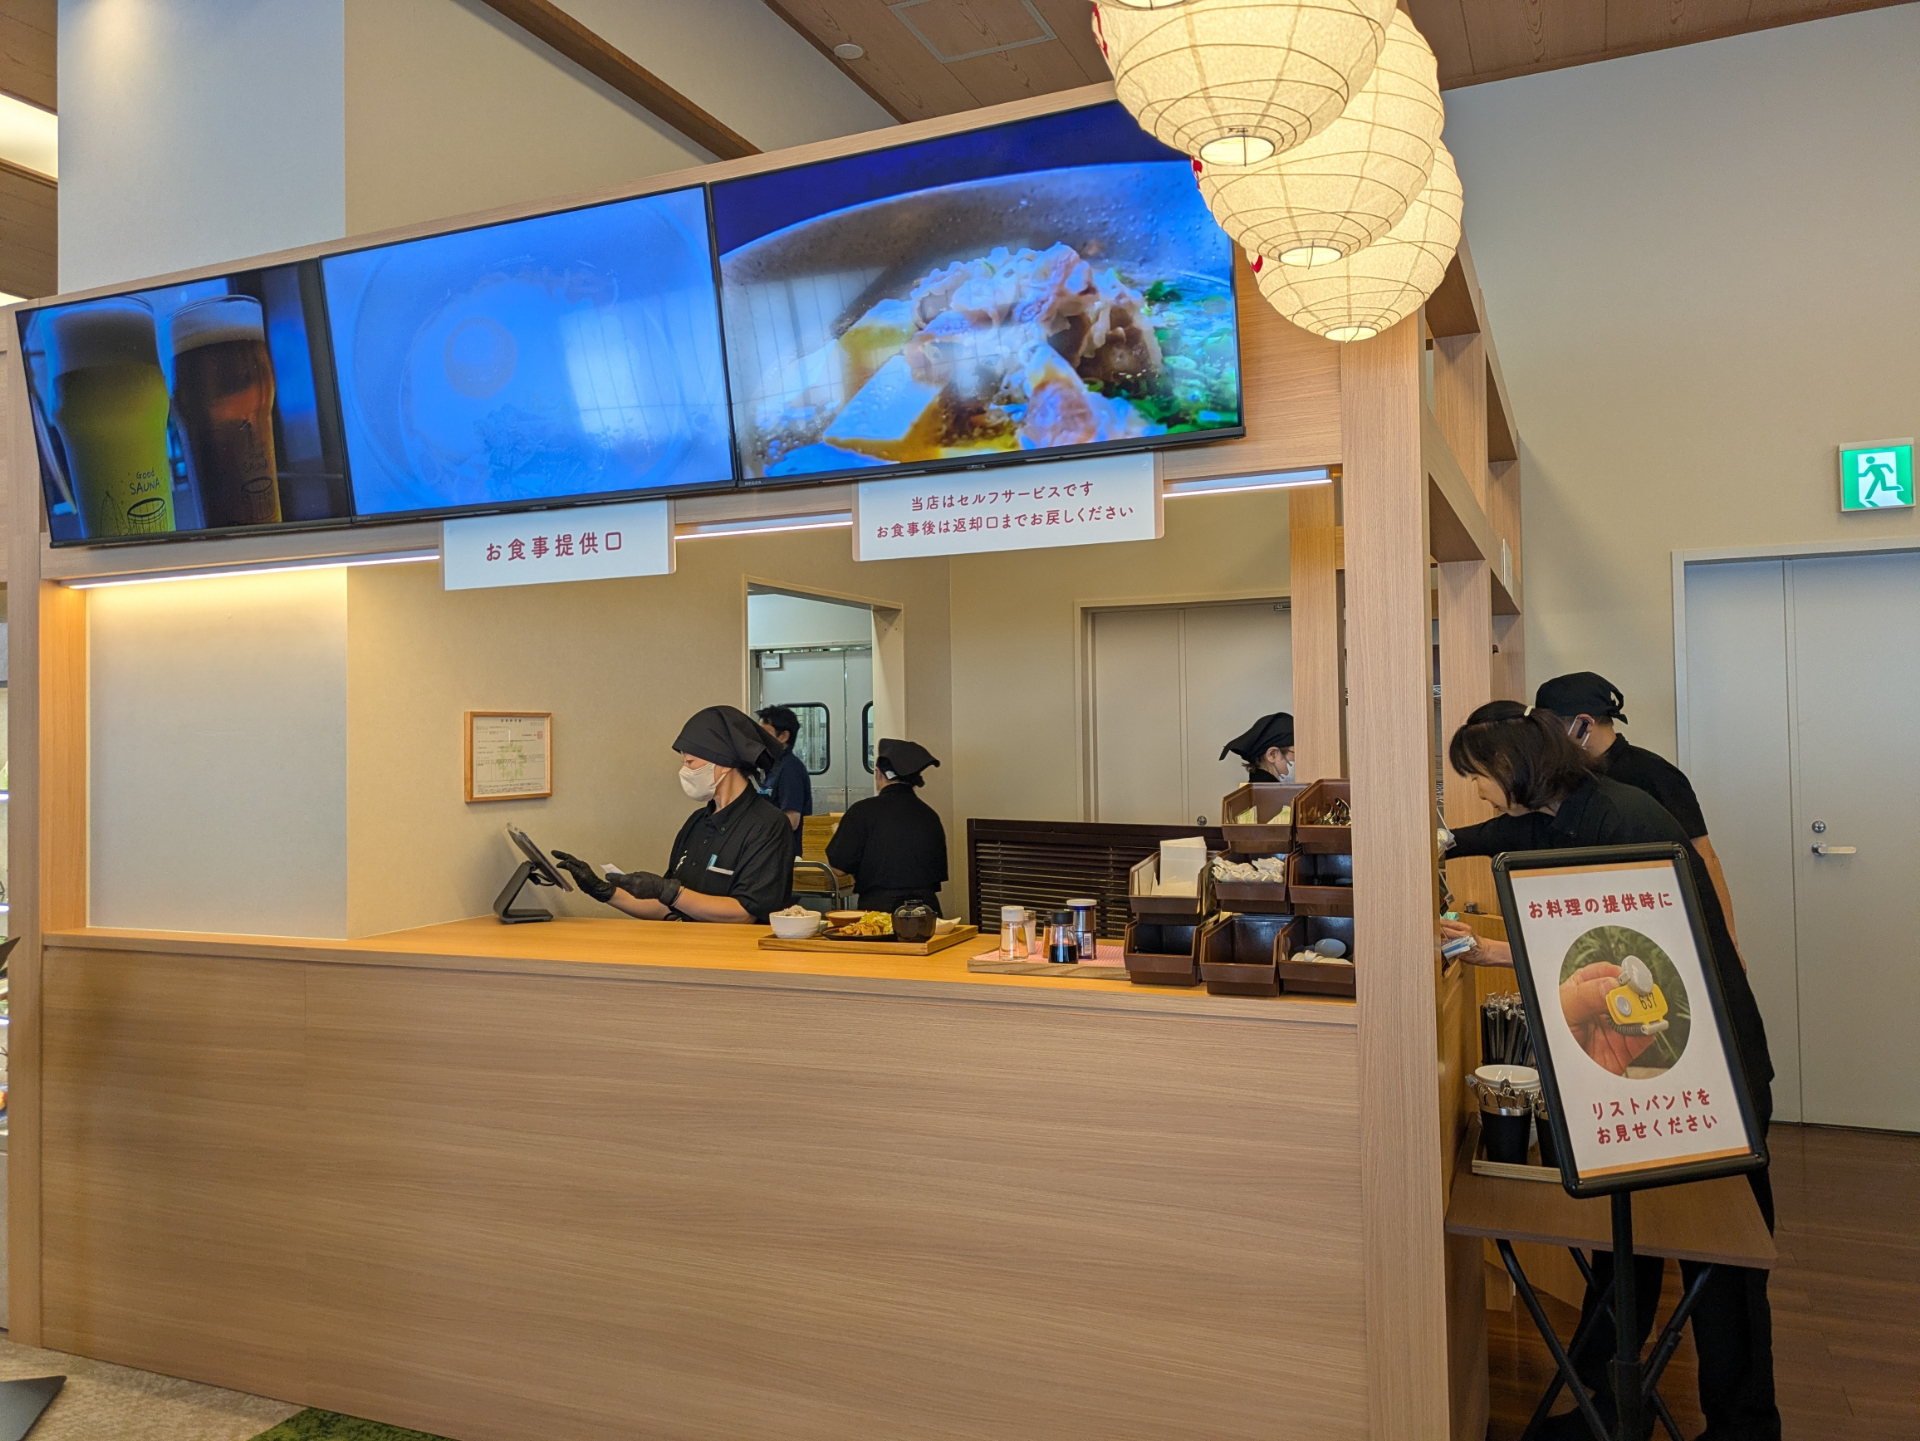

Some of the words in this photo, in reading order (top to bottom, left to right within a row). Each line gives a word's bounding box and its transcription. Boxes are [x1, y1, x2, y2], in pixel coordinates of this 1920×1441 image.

[129, 478, 160, 495] SAUNA
[911, 480, 1094, 512] 当店はセルフサービスです
[876, 505, 1135, 539] お食事後は返却口までお戻しください
[486, 531, 622, 562] お食事提供口
[1529, 891, 1674, 919] お料理の提供時に
[1638, 991, 1658, 1010] 637
[1592, 1087, 1711, 1120] リストバンドを
[1597, 1113, 1719, 1145] お見せください
